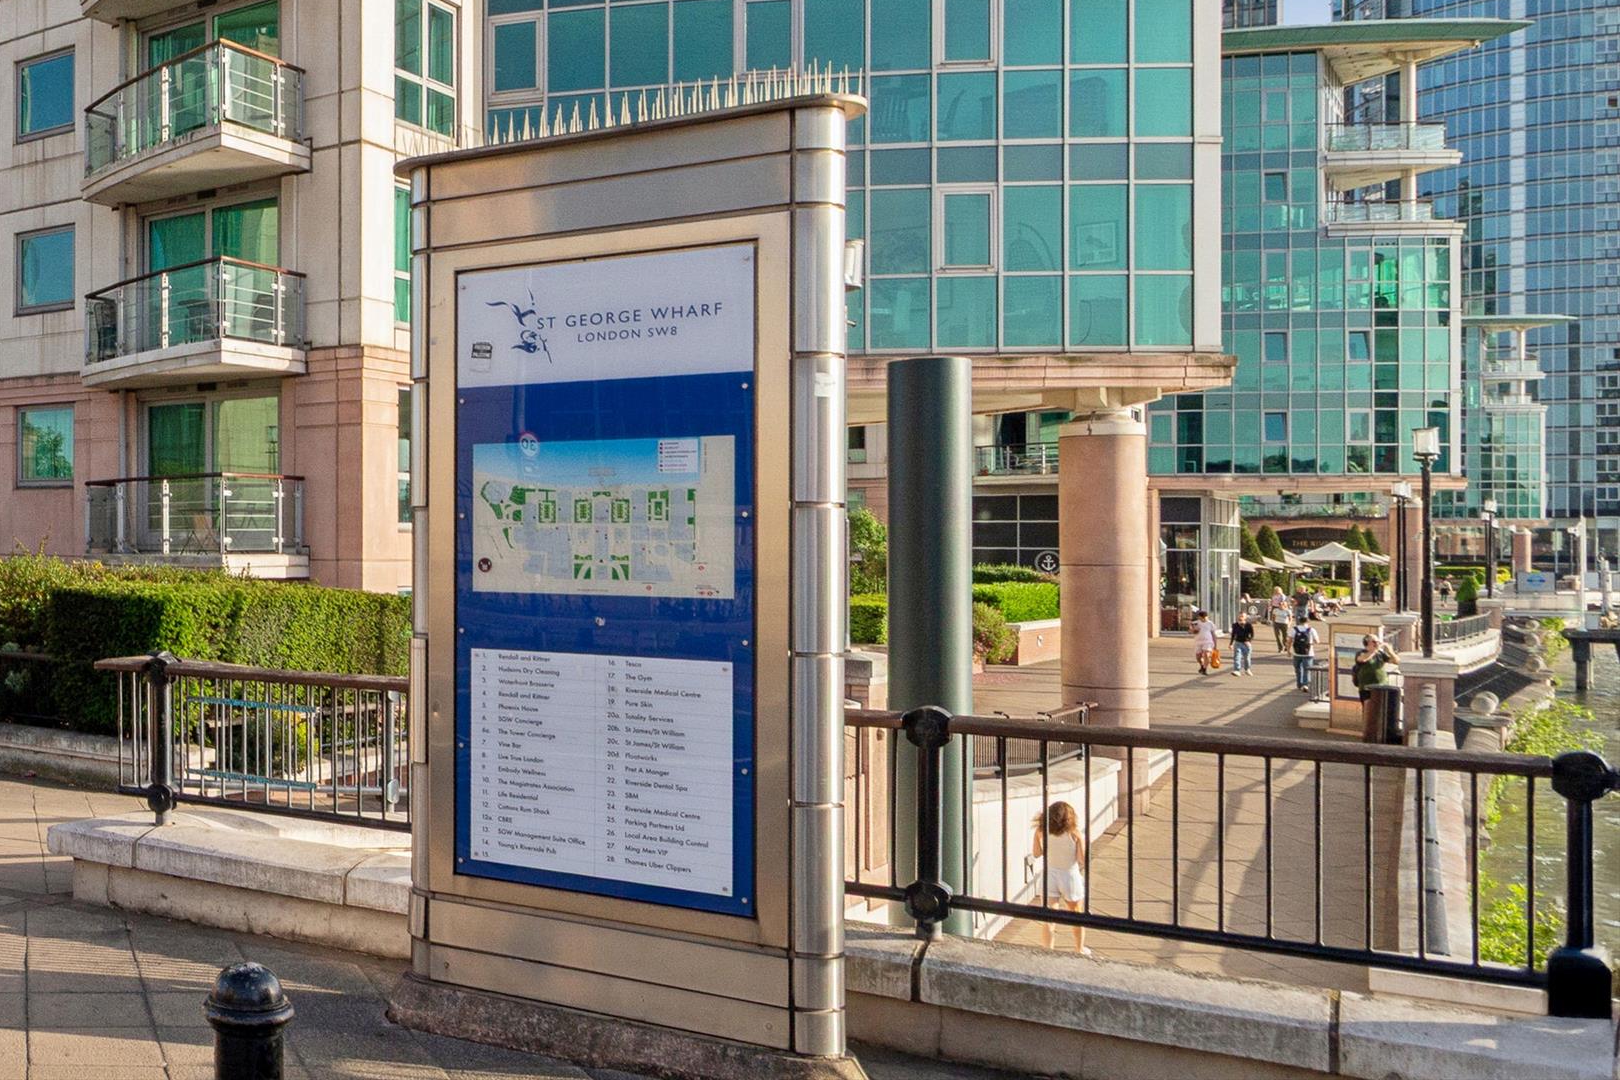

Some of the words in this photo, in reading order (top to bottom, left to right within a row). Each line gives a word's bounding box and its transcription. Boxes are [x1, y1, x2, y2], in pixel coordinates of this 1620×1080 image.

[537, 317, 556, 329] ST
[565, 310, 642, 328] GEORGE
[650, 302, 723, 320] WHARF
[577, 329, 641, 343] LONDON
[648, 326, 678, 338] SW8
[514, 717, 542, 726] Concierge
[648, 715, 673, 723] Services
[527, 731, 555, 740] Concierge
[625, 779, 651, 787] Riverside
[654, 782, 673, 790] Dental
[654, 809, 678, 817] Medical
[680, 812, 700, 820] Centre
[625, 819, 647, 828] Parking
[649, 821, 673, 830] Partners
[515, 831, 551, 840] Management
[659, 837, 684, 846] Building
[520, 844, 544, 853] Riverside
[625, 858, 647, 867] Thames
[666, 864, 691, 873] Clippers
